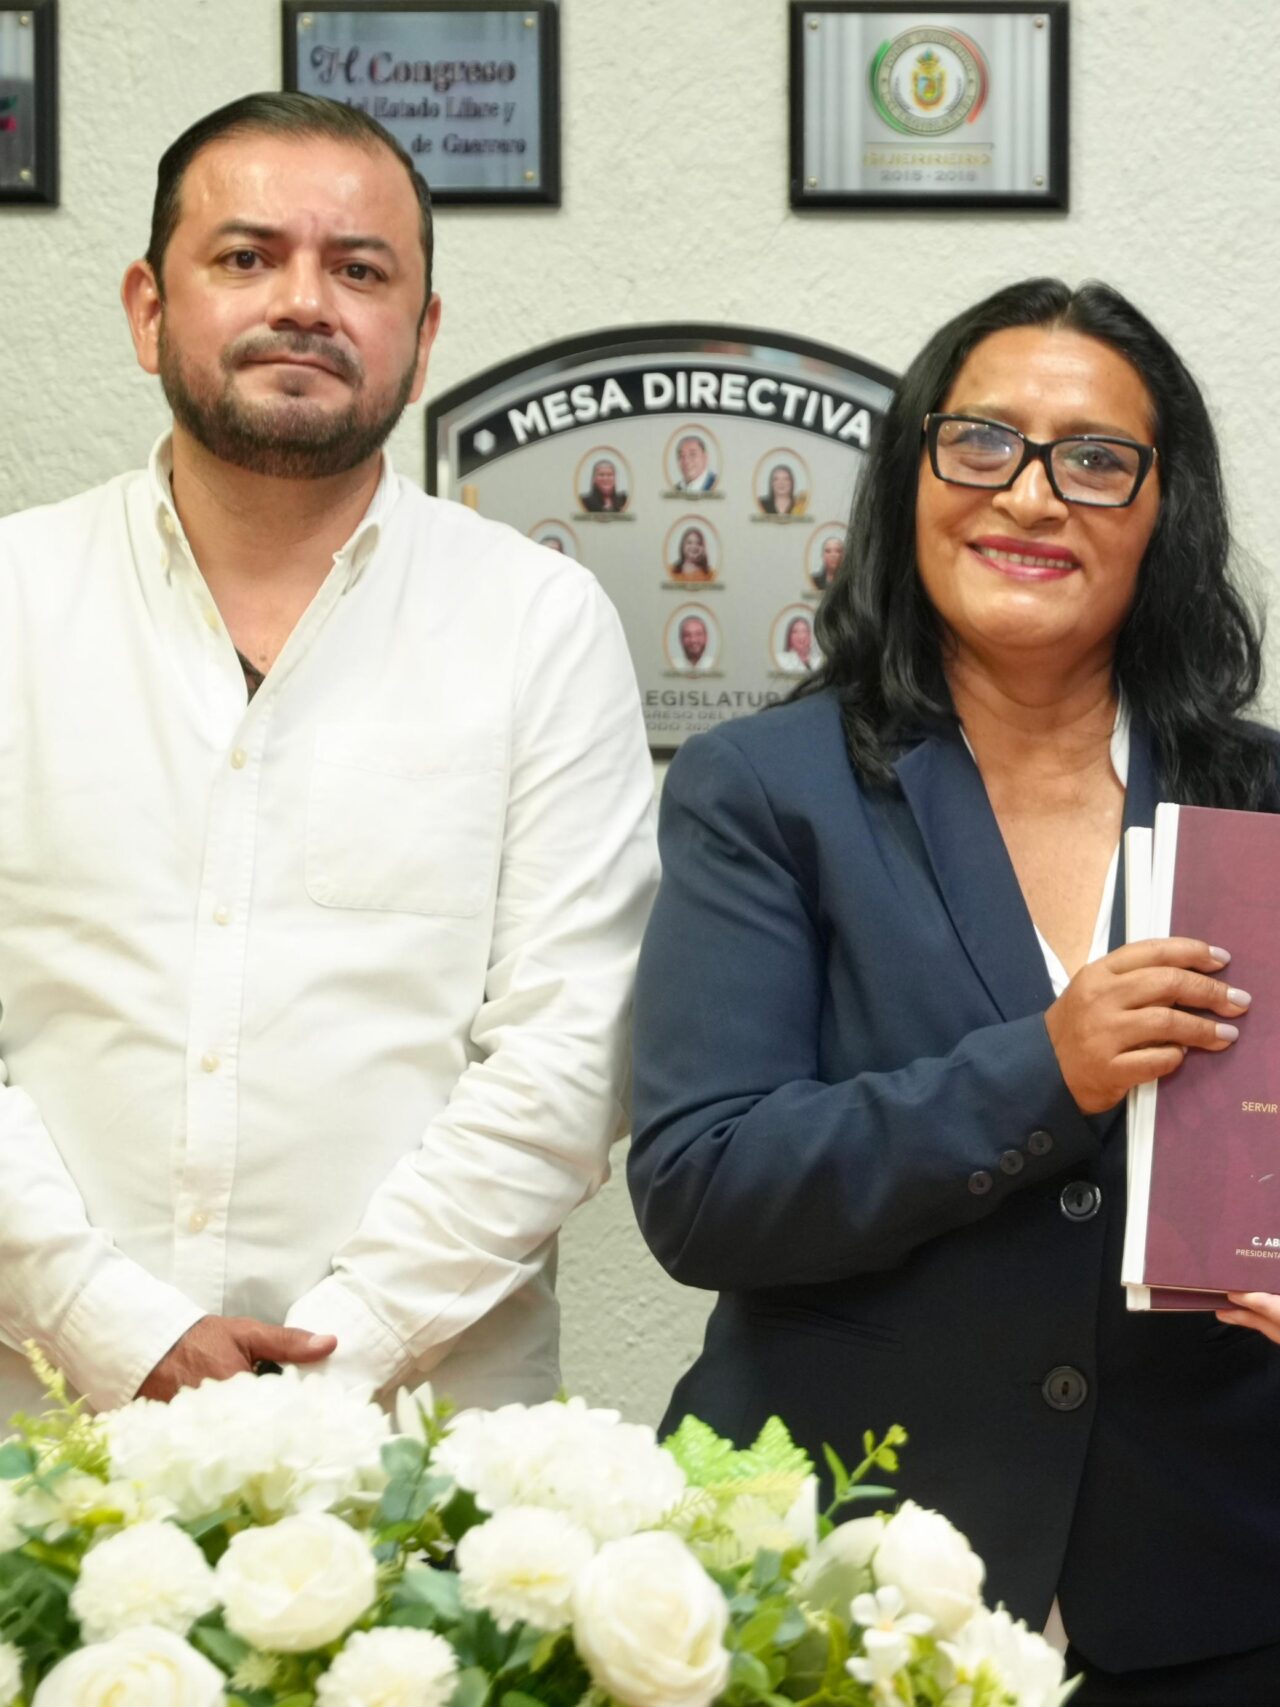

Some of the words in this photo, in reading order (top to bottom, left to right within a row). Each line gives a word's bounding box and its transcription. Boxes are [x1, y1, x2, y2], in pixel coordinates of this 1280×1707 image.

[369, 52, 517, 92] Congreso
[374, 97, 440, 119] Estado
[411, 134, 433, 154] de
[442, 133, 528, 154] Guerrero
[863, 152, 992, 167] GUERRERO
[507, 378, 633, 444] MESA
[643, 371, 872, 448] DIRECTIVA
[642, 690, 784, 707] EGISLATUR
[1241, 1101, 1278, 1114] SERVIR
[1251, 1236, 1262, 1246] C.
